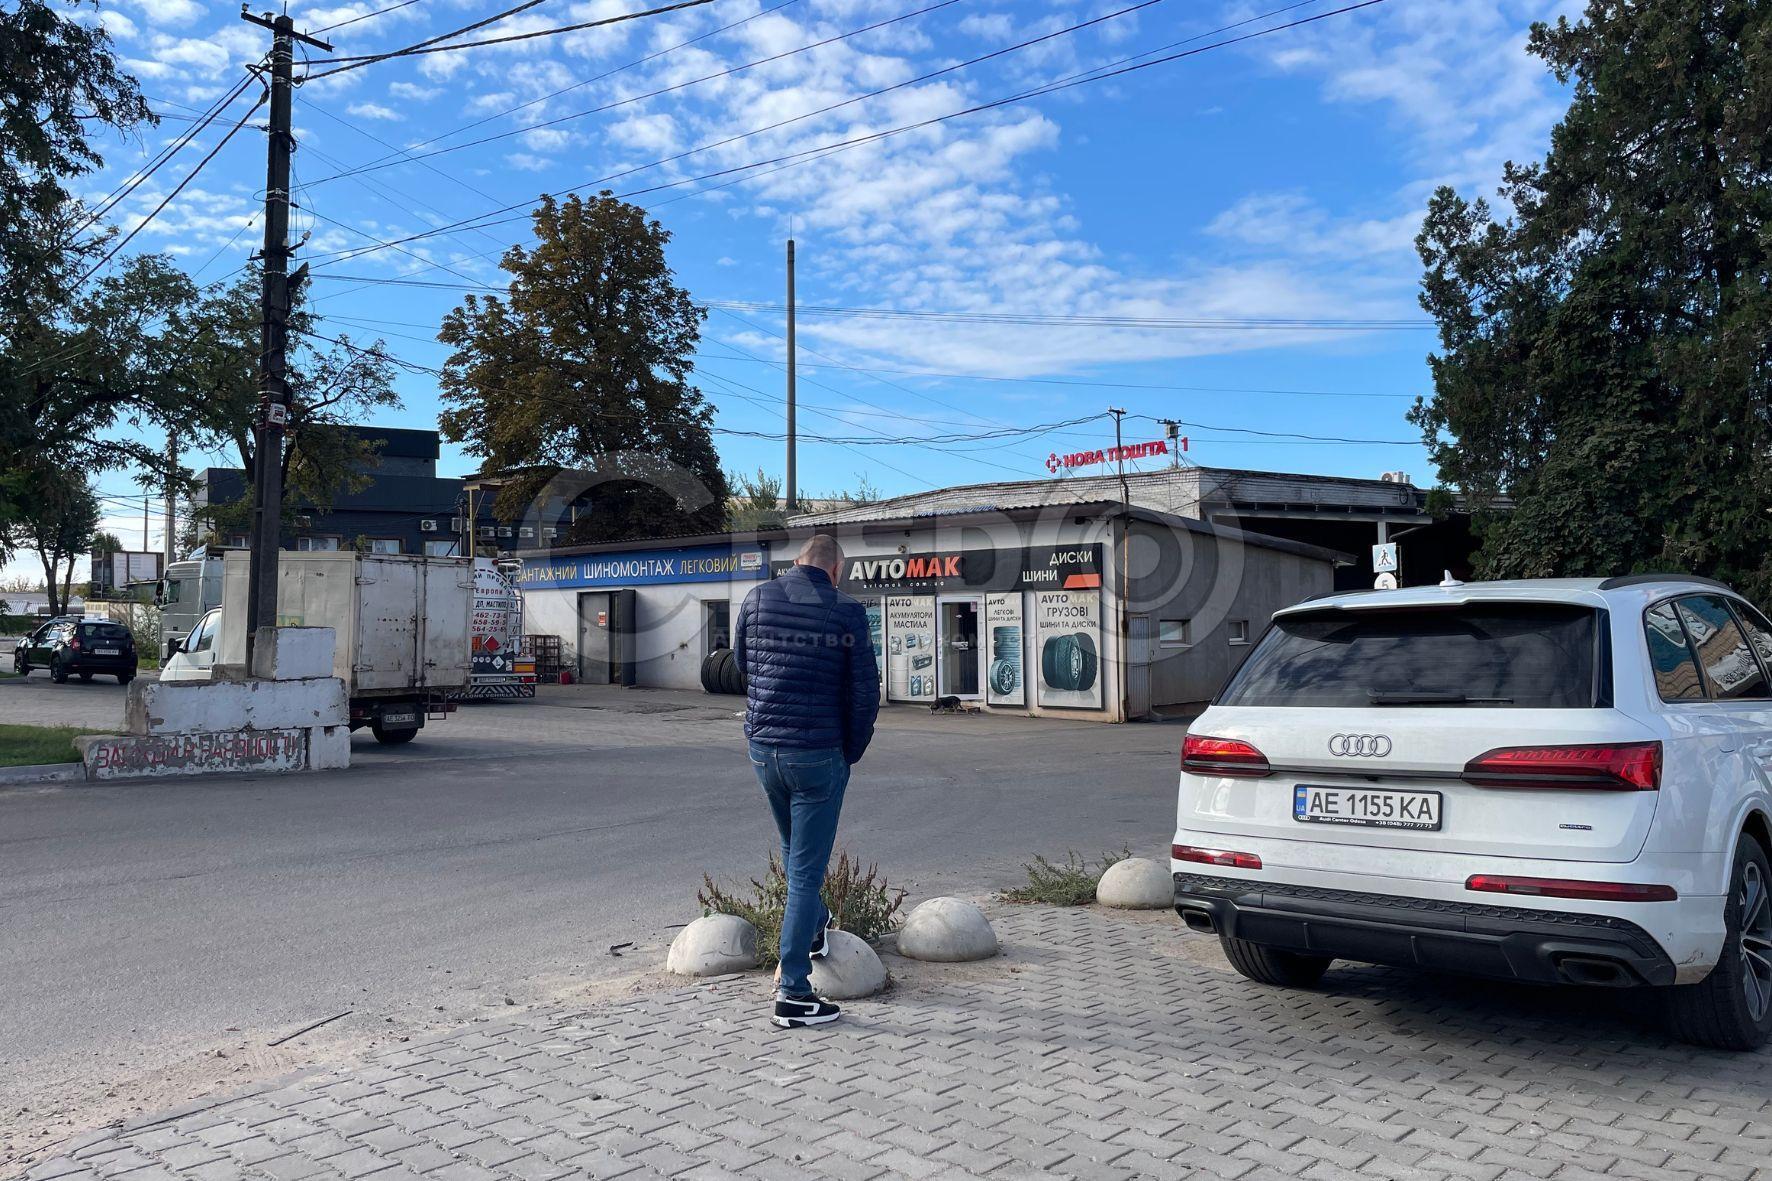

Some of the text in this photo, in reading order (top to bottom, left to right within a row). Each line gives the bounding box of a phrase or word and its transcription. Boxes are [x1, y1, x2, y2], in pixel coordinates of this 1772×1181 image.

[1063, 437, 1189, 468] НОВА ПОШТА 1
[1049, 550, 1093, 566] ДИСКИ
[583, 558, 675, 580] ШИНОМОНТАЖ
[679, 553, 738, 575] ЛЕГКОВИЙ
[849, 556, 960, 580] AVTOMAK
[1022, 569, 1058, 582] ШИНИ
[889, 611, 933, 619] АКУМУЛЯТОРИ
[1046, 607, 1088, 617] ГРУЗОВІ
[893, 621, 928, 629] МАСТИЛА
[1071, 620, 1097, 629] ДИСКИ
[1296, 804, 1305, 812] UA
[1310, 791, 1433, 820] AE 1155 KA
